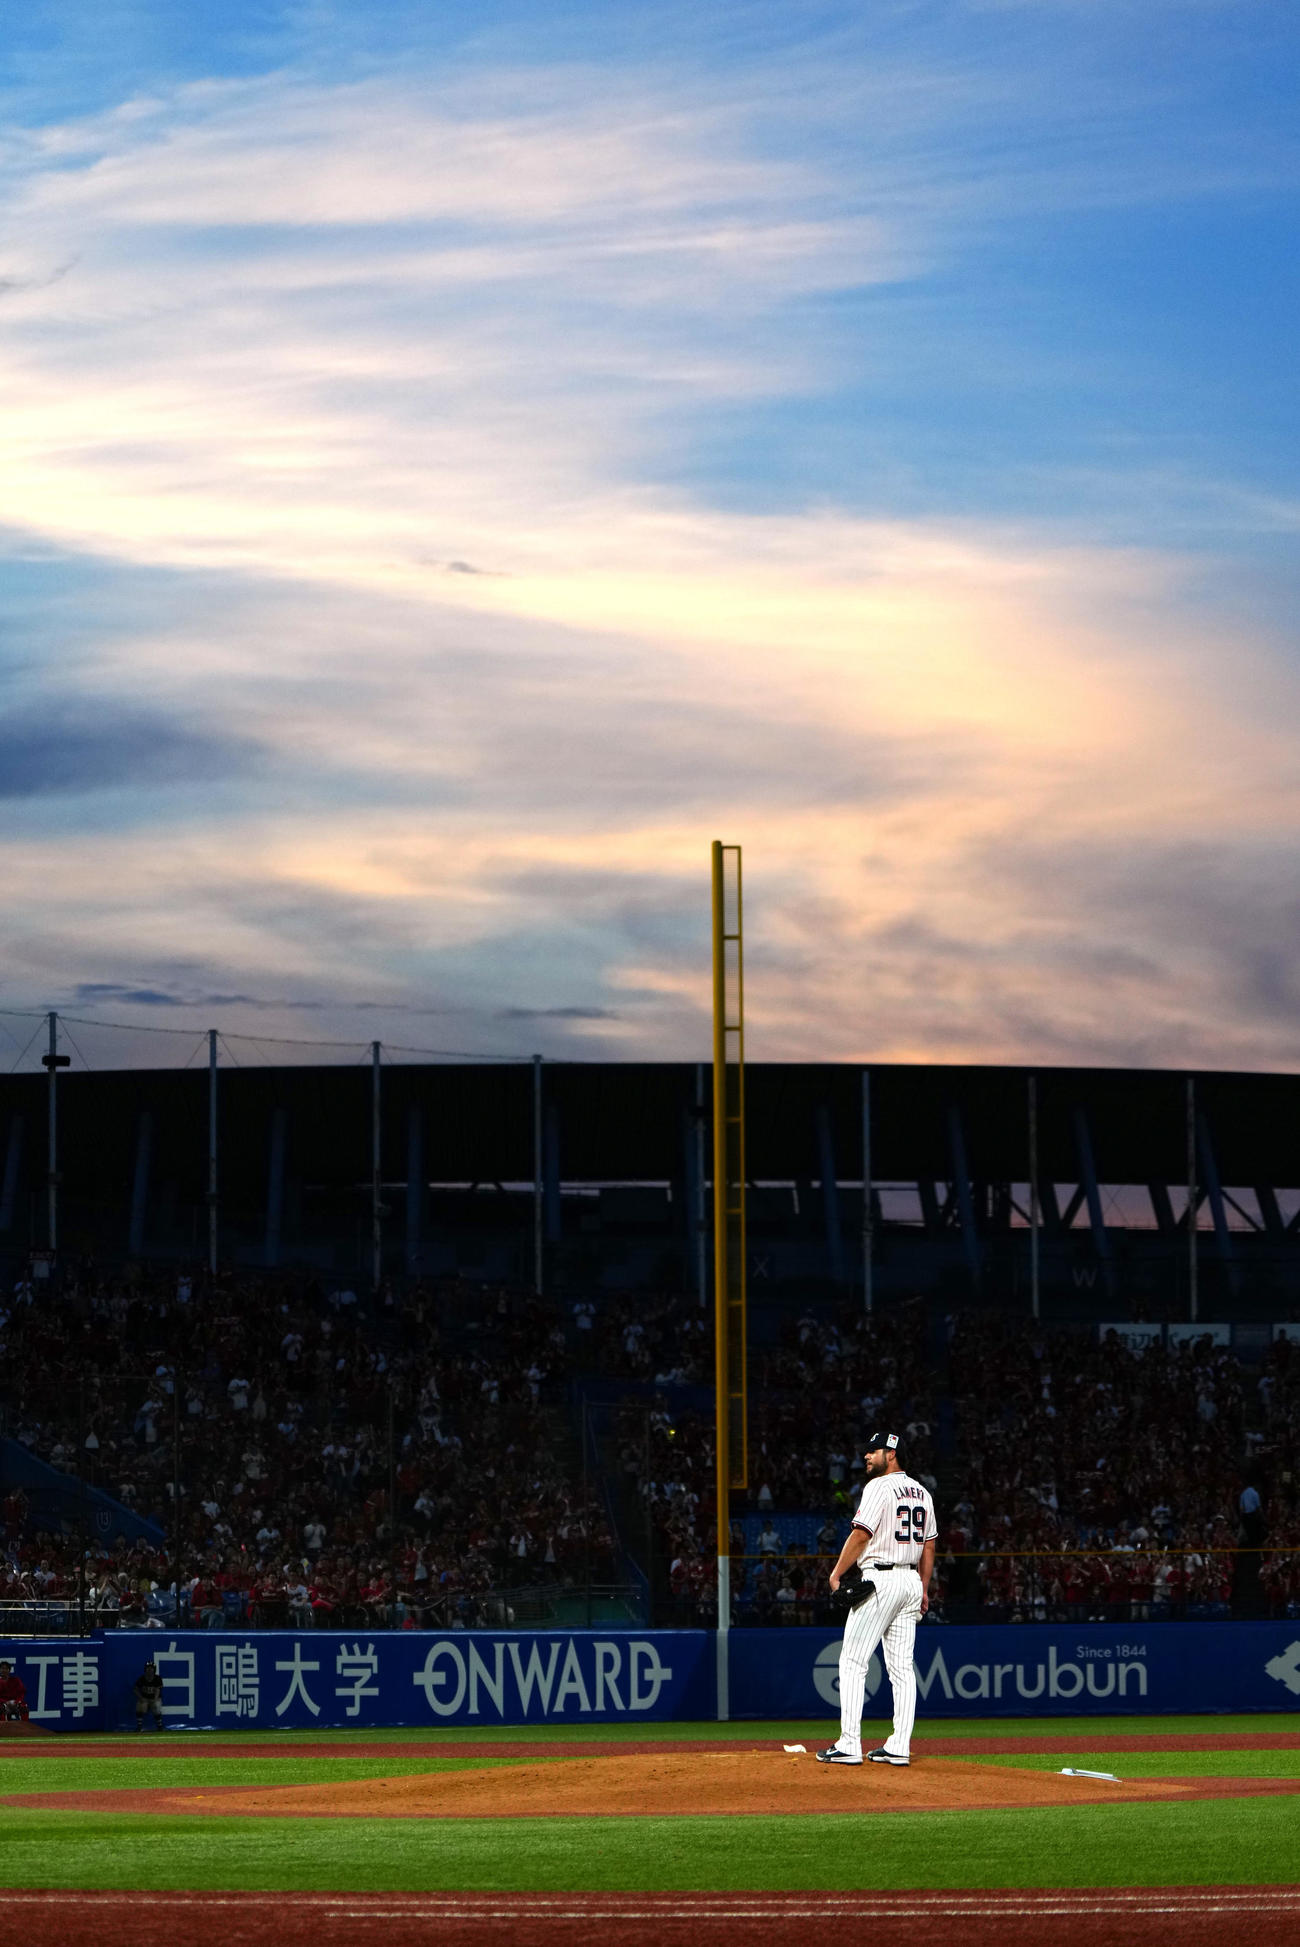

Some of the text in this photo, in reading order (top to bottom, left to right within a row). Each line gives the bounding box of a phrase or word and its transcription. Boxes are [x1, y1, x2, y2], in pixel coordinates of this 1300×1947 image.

[752, 1256, 770, 1278] X
[1072, 1267, 1097, 1288] W
[895, 1505, 927, 1544] 39
[1076, 1644, 1147, 1658] Since 1844
[0, 1652, 98, 1719] 工事
[413, 1637, 672, 1717] ONWARD
[913, 1645, 1148, 1701] Marubun
